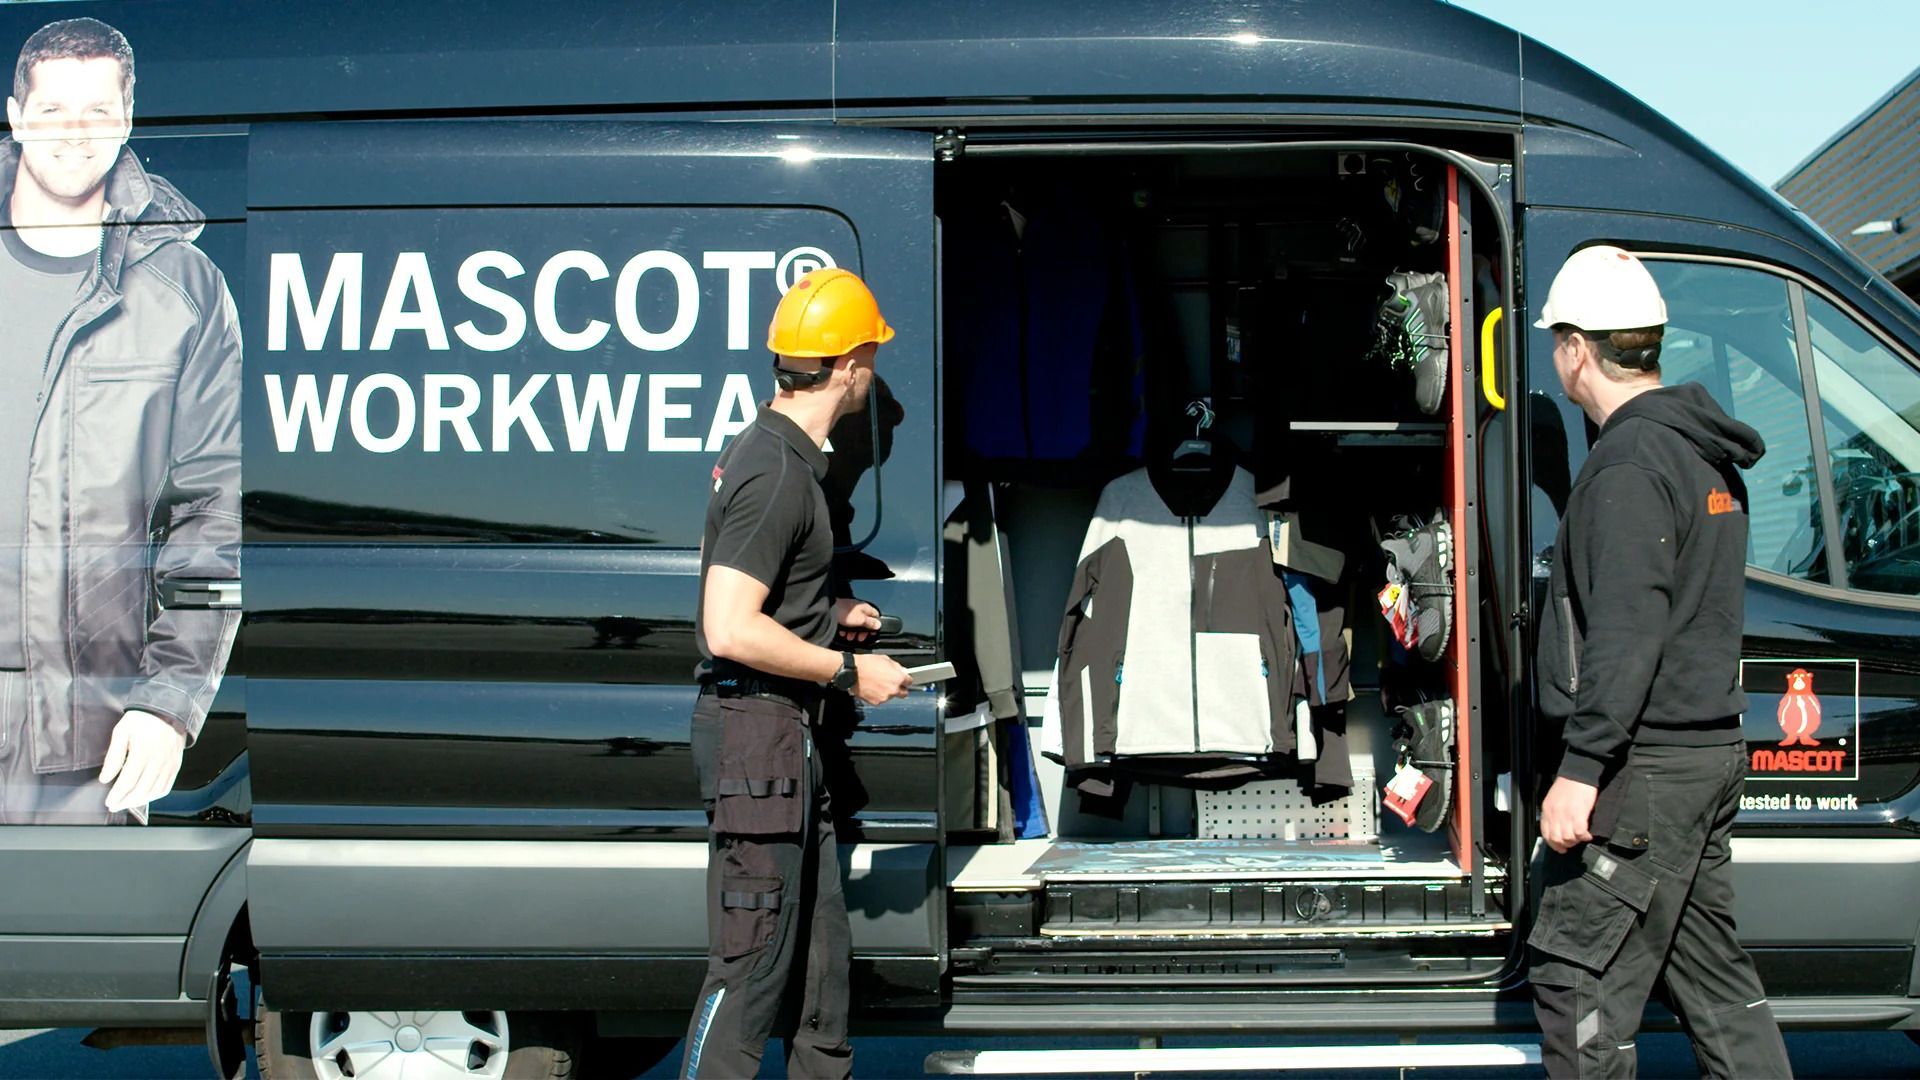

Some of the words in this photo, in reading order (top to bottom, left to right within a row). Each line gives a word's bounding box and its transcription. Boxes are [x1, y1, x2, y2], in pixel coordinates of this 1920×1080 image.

[264, 373, 834, 453] WORKWEA
[1753, 751, 1846, 771] MASCOT
[1739, 794, 1790, 810] tested
[1795, 794, 1812, 810] to
[1816, 794, 1858, 810] work
